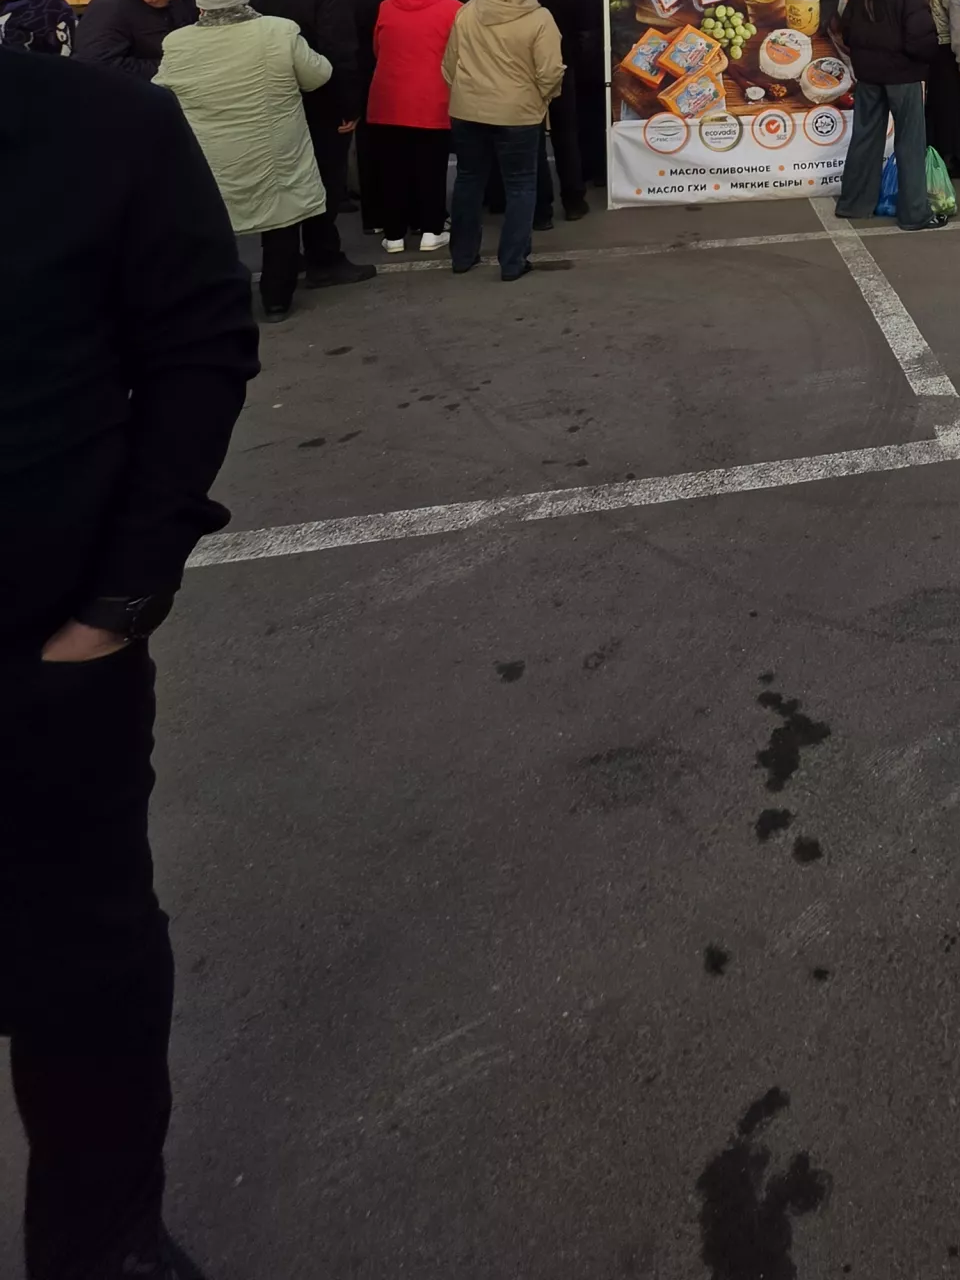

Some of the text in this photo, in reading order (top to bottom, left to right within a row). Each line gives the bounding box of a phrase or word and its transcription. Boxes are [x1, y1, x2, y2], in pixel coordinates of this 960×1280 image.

[705, 128, 737, 137] ecovadis
[670, 168, 706, 176] МАСЛО
[709, 165, 771, 175] СЛИВОЧНОЕ
[647, 186, 684, 194] МАСЛО
[687, 184, 707, 192] ГХИ
[730, 181, 770, 189] МЯГКИЕ
[773, 179, 802, 188] СЫРЫ
